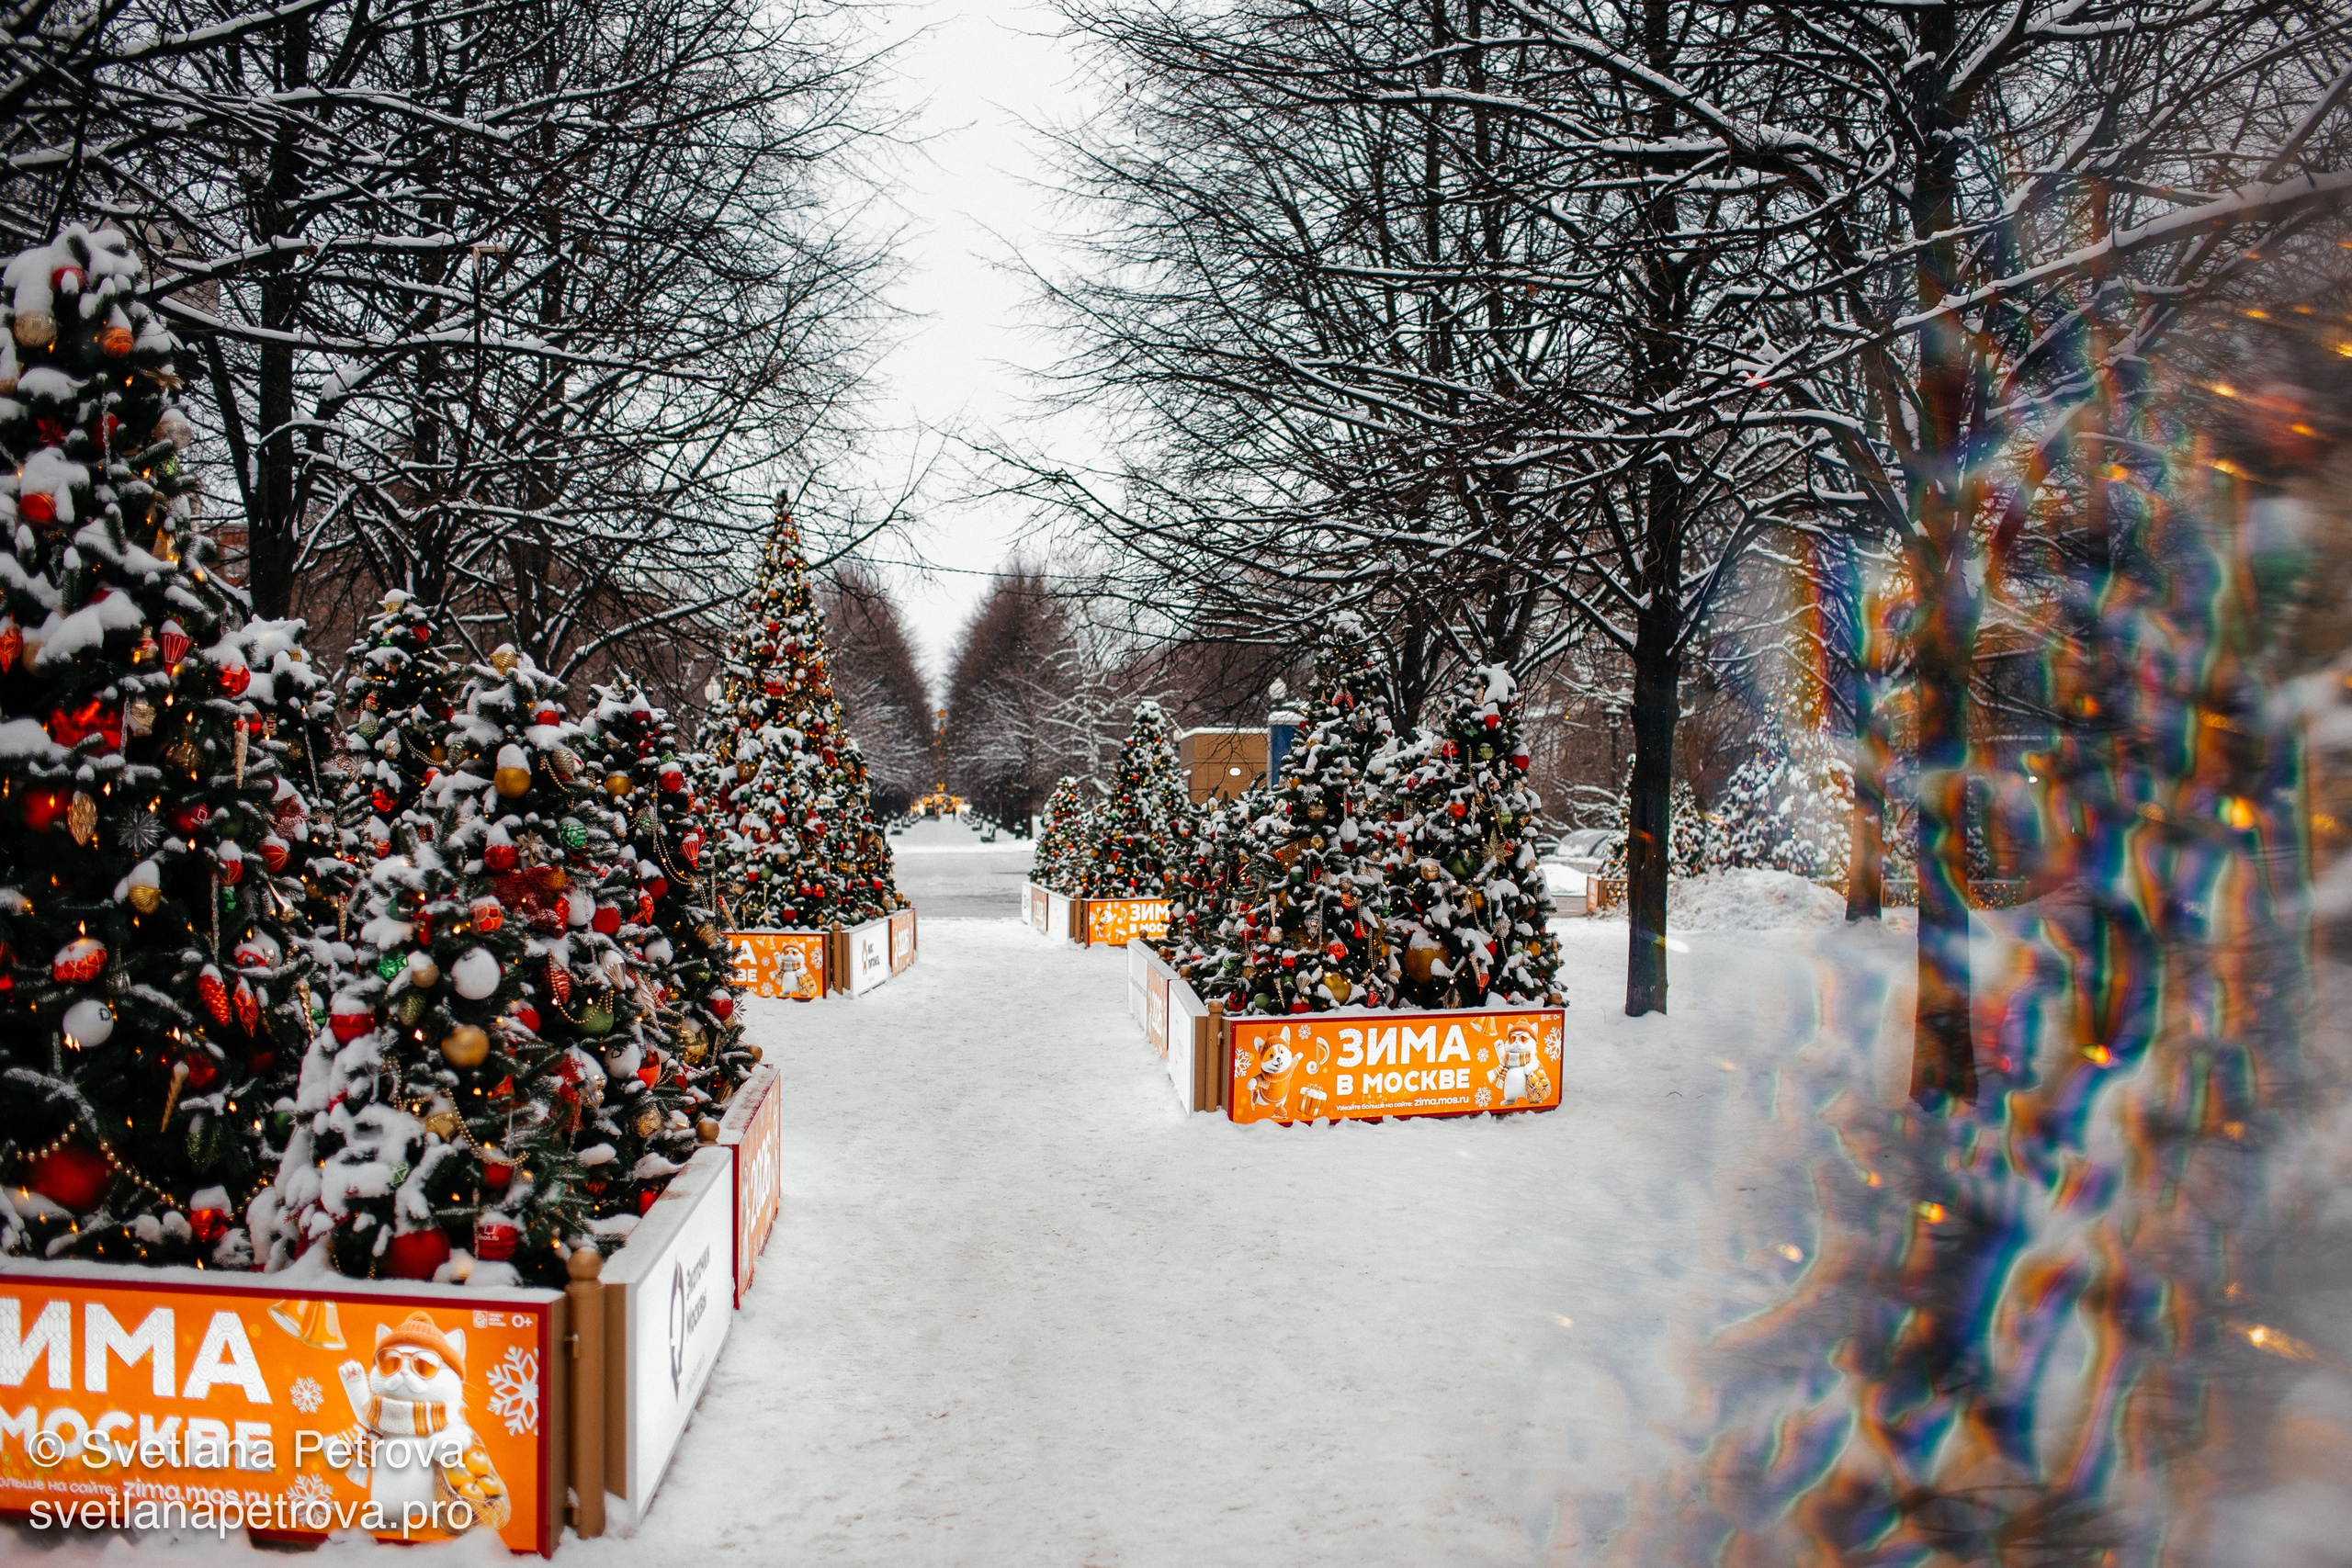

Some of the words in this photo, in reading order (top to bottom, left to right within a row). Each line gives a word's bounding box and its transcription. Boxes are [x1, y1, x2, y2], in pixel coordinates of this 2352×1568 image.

[1129, 903, 1170, 922] ЗИМ
[1139, 922, 1170, 933] МОСК
[1337, 1024, 1471, 1067] ЗИМА
[1336, 1074, 1354, 1096] В
[1363, 1068, 1470, 1095] МОСКВЕ
[1414, 1096, 1469, 1106] zima.mos.ru
[751, 1129, 771, 1234] 2026
[511, 1314, 533, 1328] 0+
[0, 1297, 273, 1404] ИМА
[0, 1477, 44, 1491] ольше
[48, 1480, 67, 1493] на
